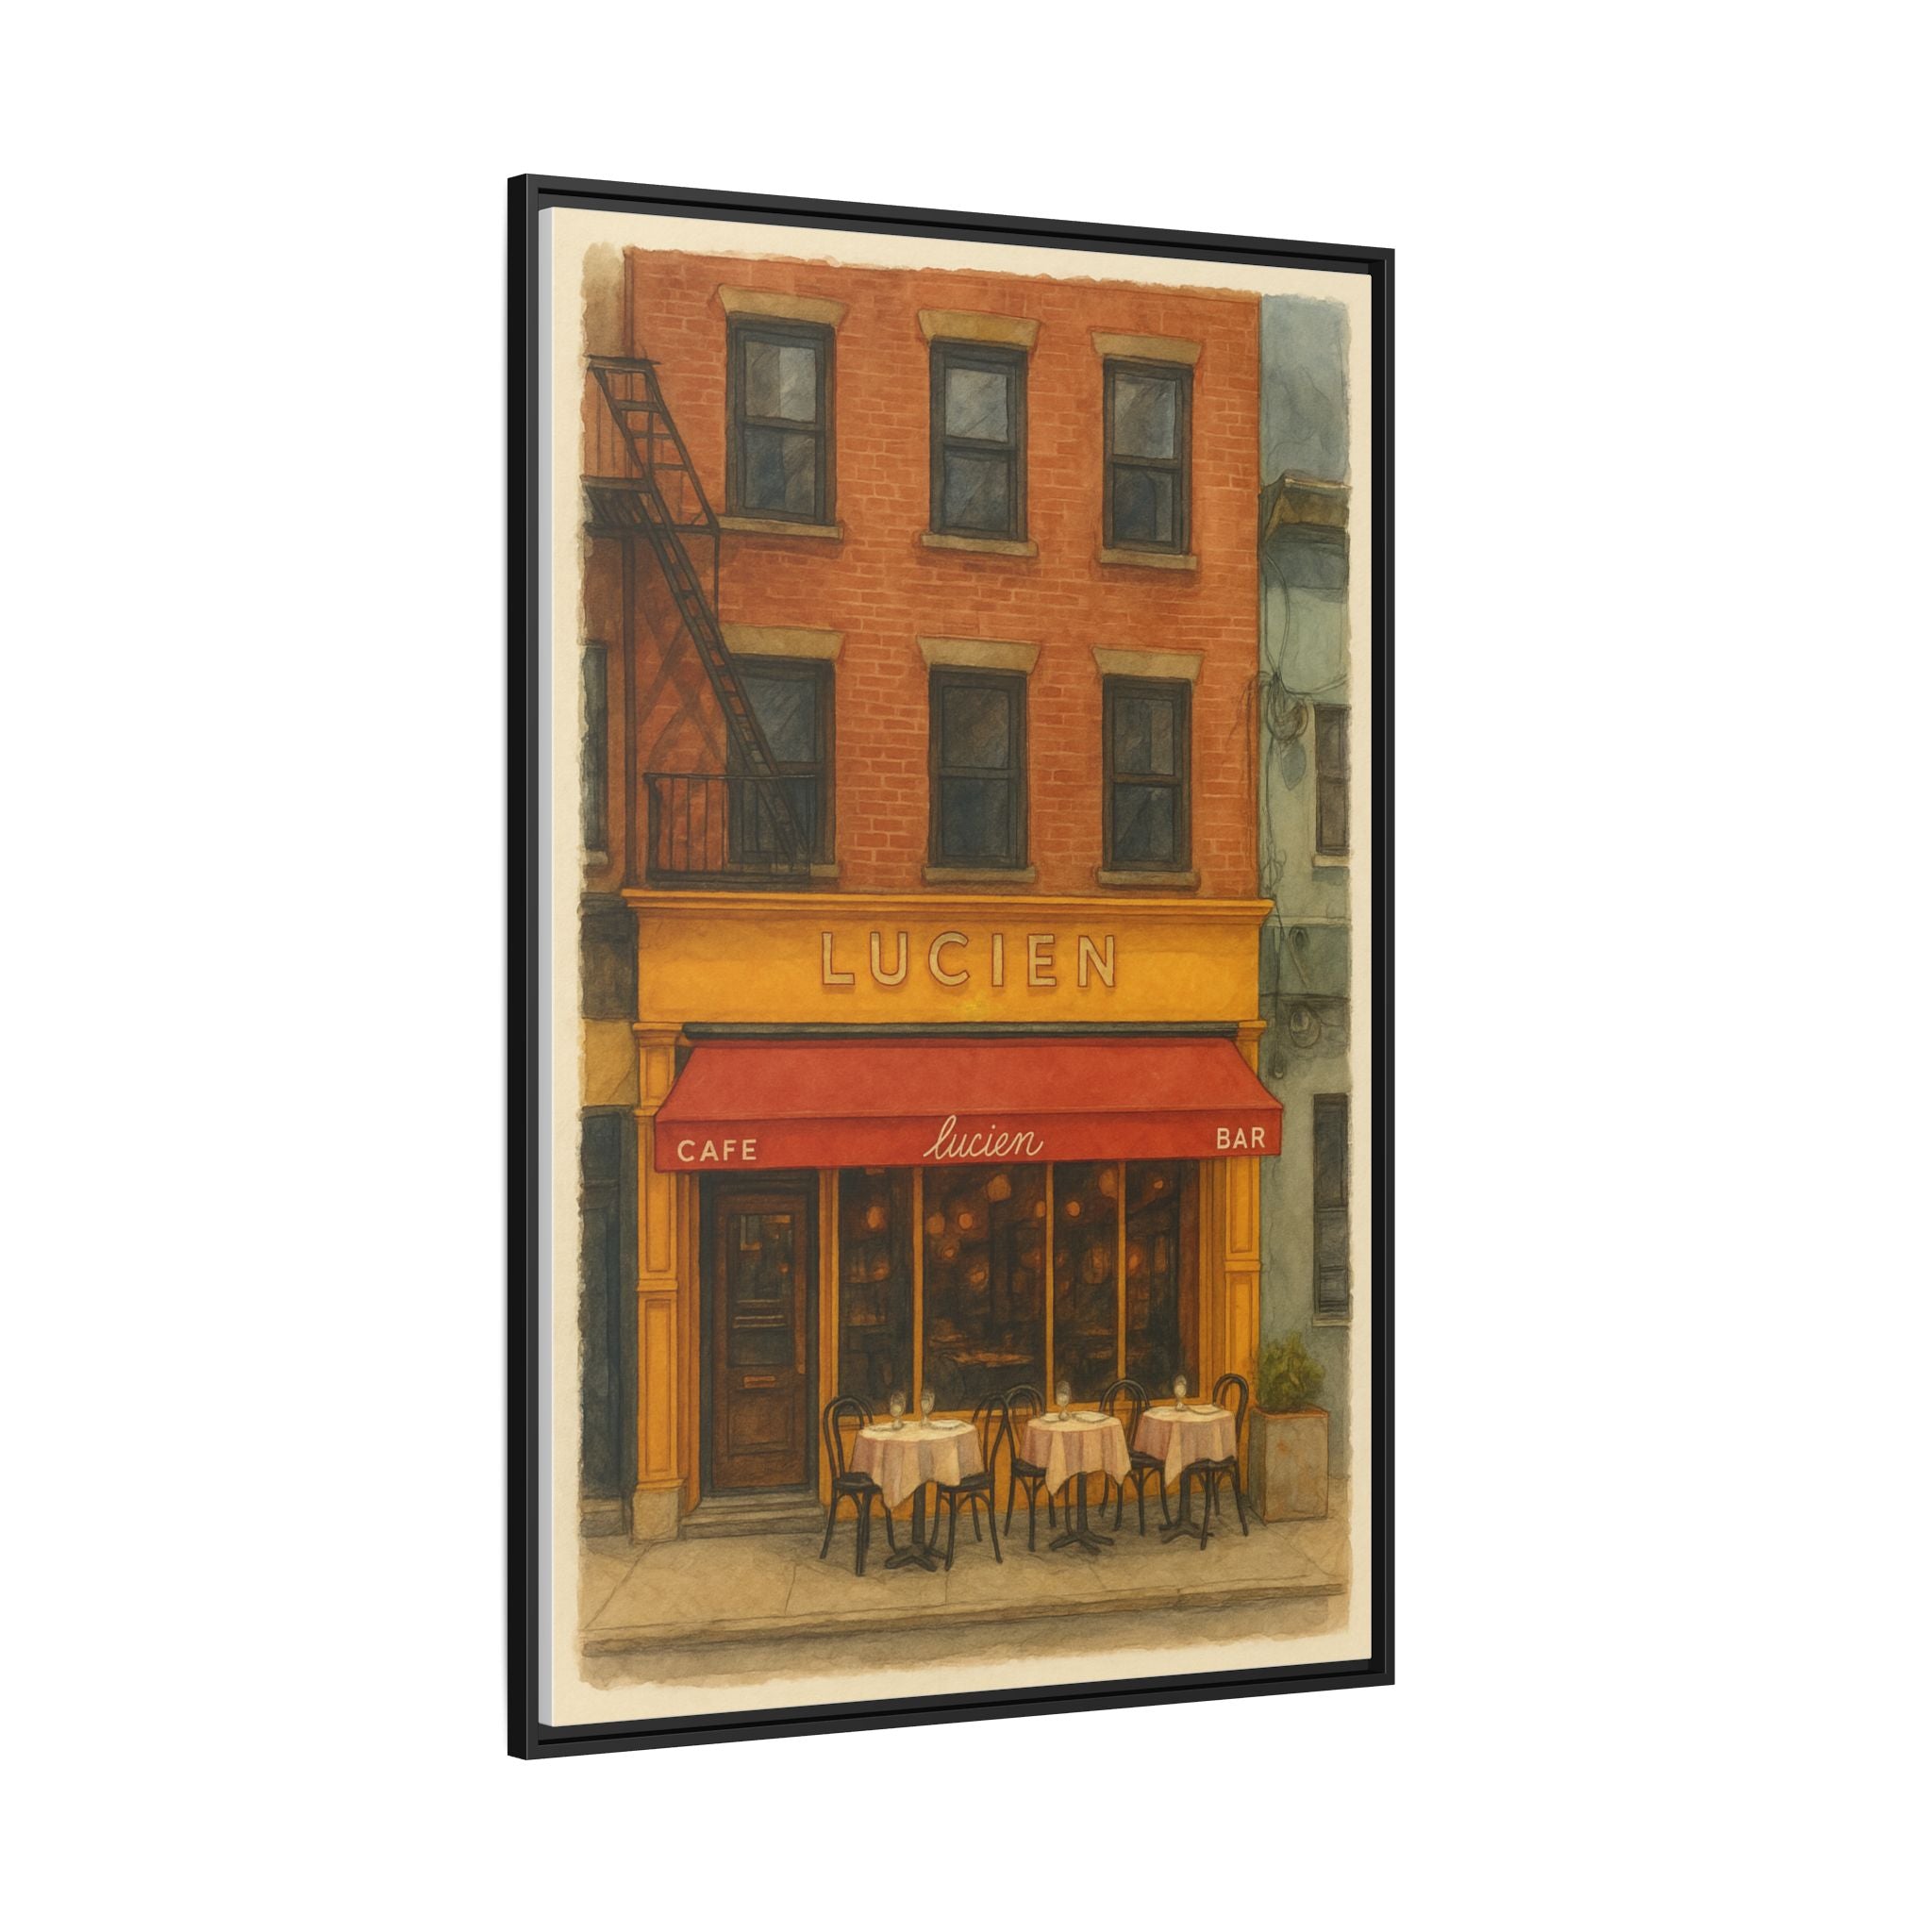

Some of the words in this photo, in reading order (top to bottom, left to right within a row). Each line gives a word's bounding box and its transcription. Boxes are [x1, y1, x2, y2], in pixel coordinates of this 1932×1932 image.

[822, 931, 1115, 987] LUCIEN
[676, 1139, 757, 1162] CAFE
[924, 1115, 1043, 1160] lucien
[1216, 1127, 1266, 1150] BAR
